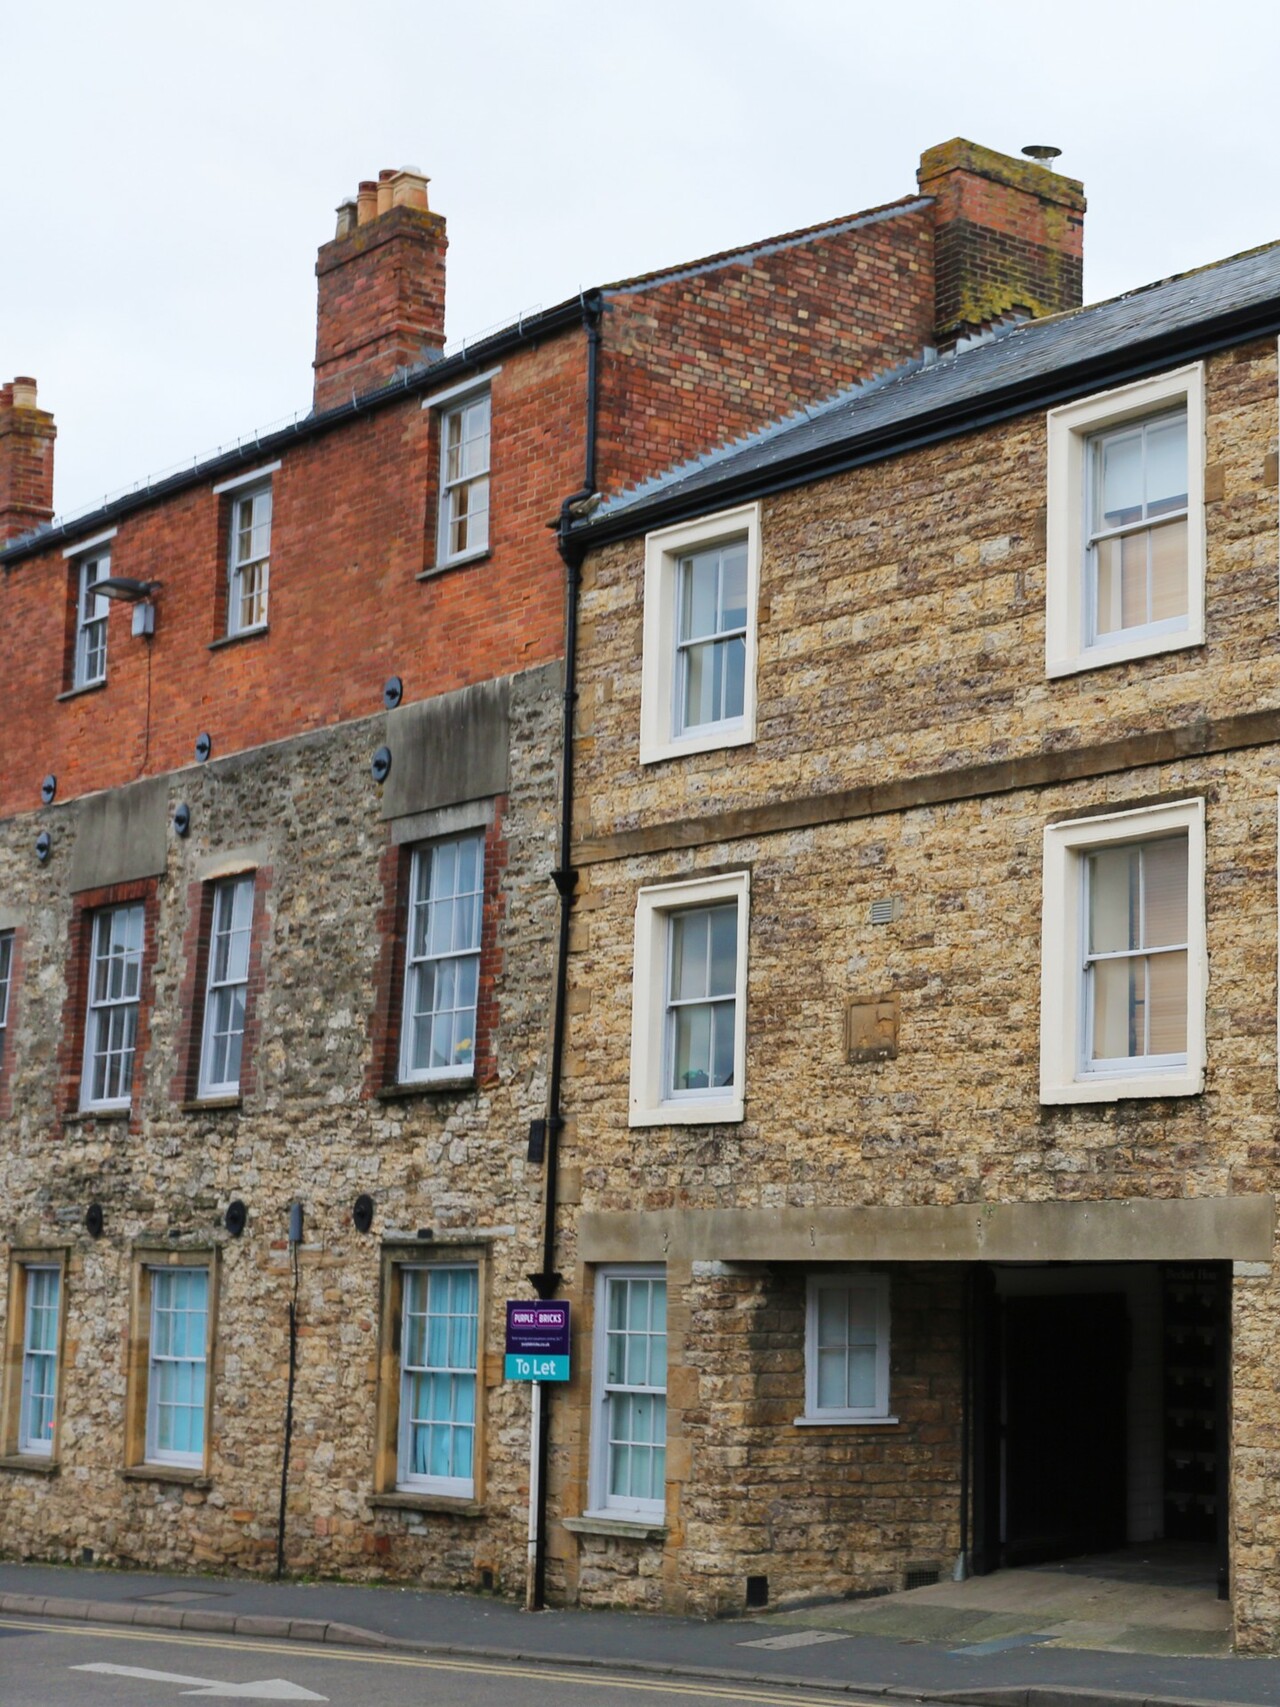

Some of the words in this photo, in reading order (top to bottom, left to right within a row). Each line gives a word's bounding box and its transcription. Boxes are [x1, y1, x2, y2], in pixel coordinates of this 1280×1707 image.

[514, 1313, 534, 1323] PURPLE
[538, 1313, 562, 1323] BRICKS
[516, 1358, 530, 1375] To
[533, 1359, 556, 1375] Let
